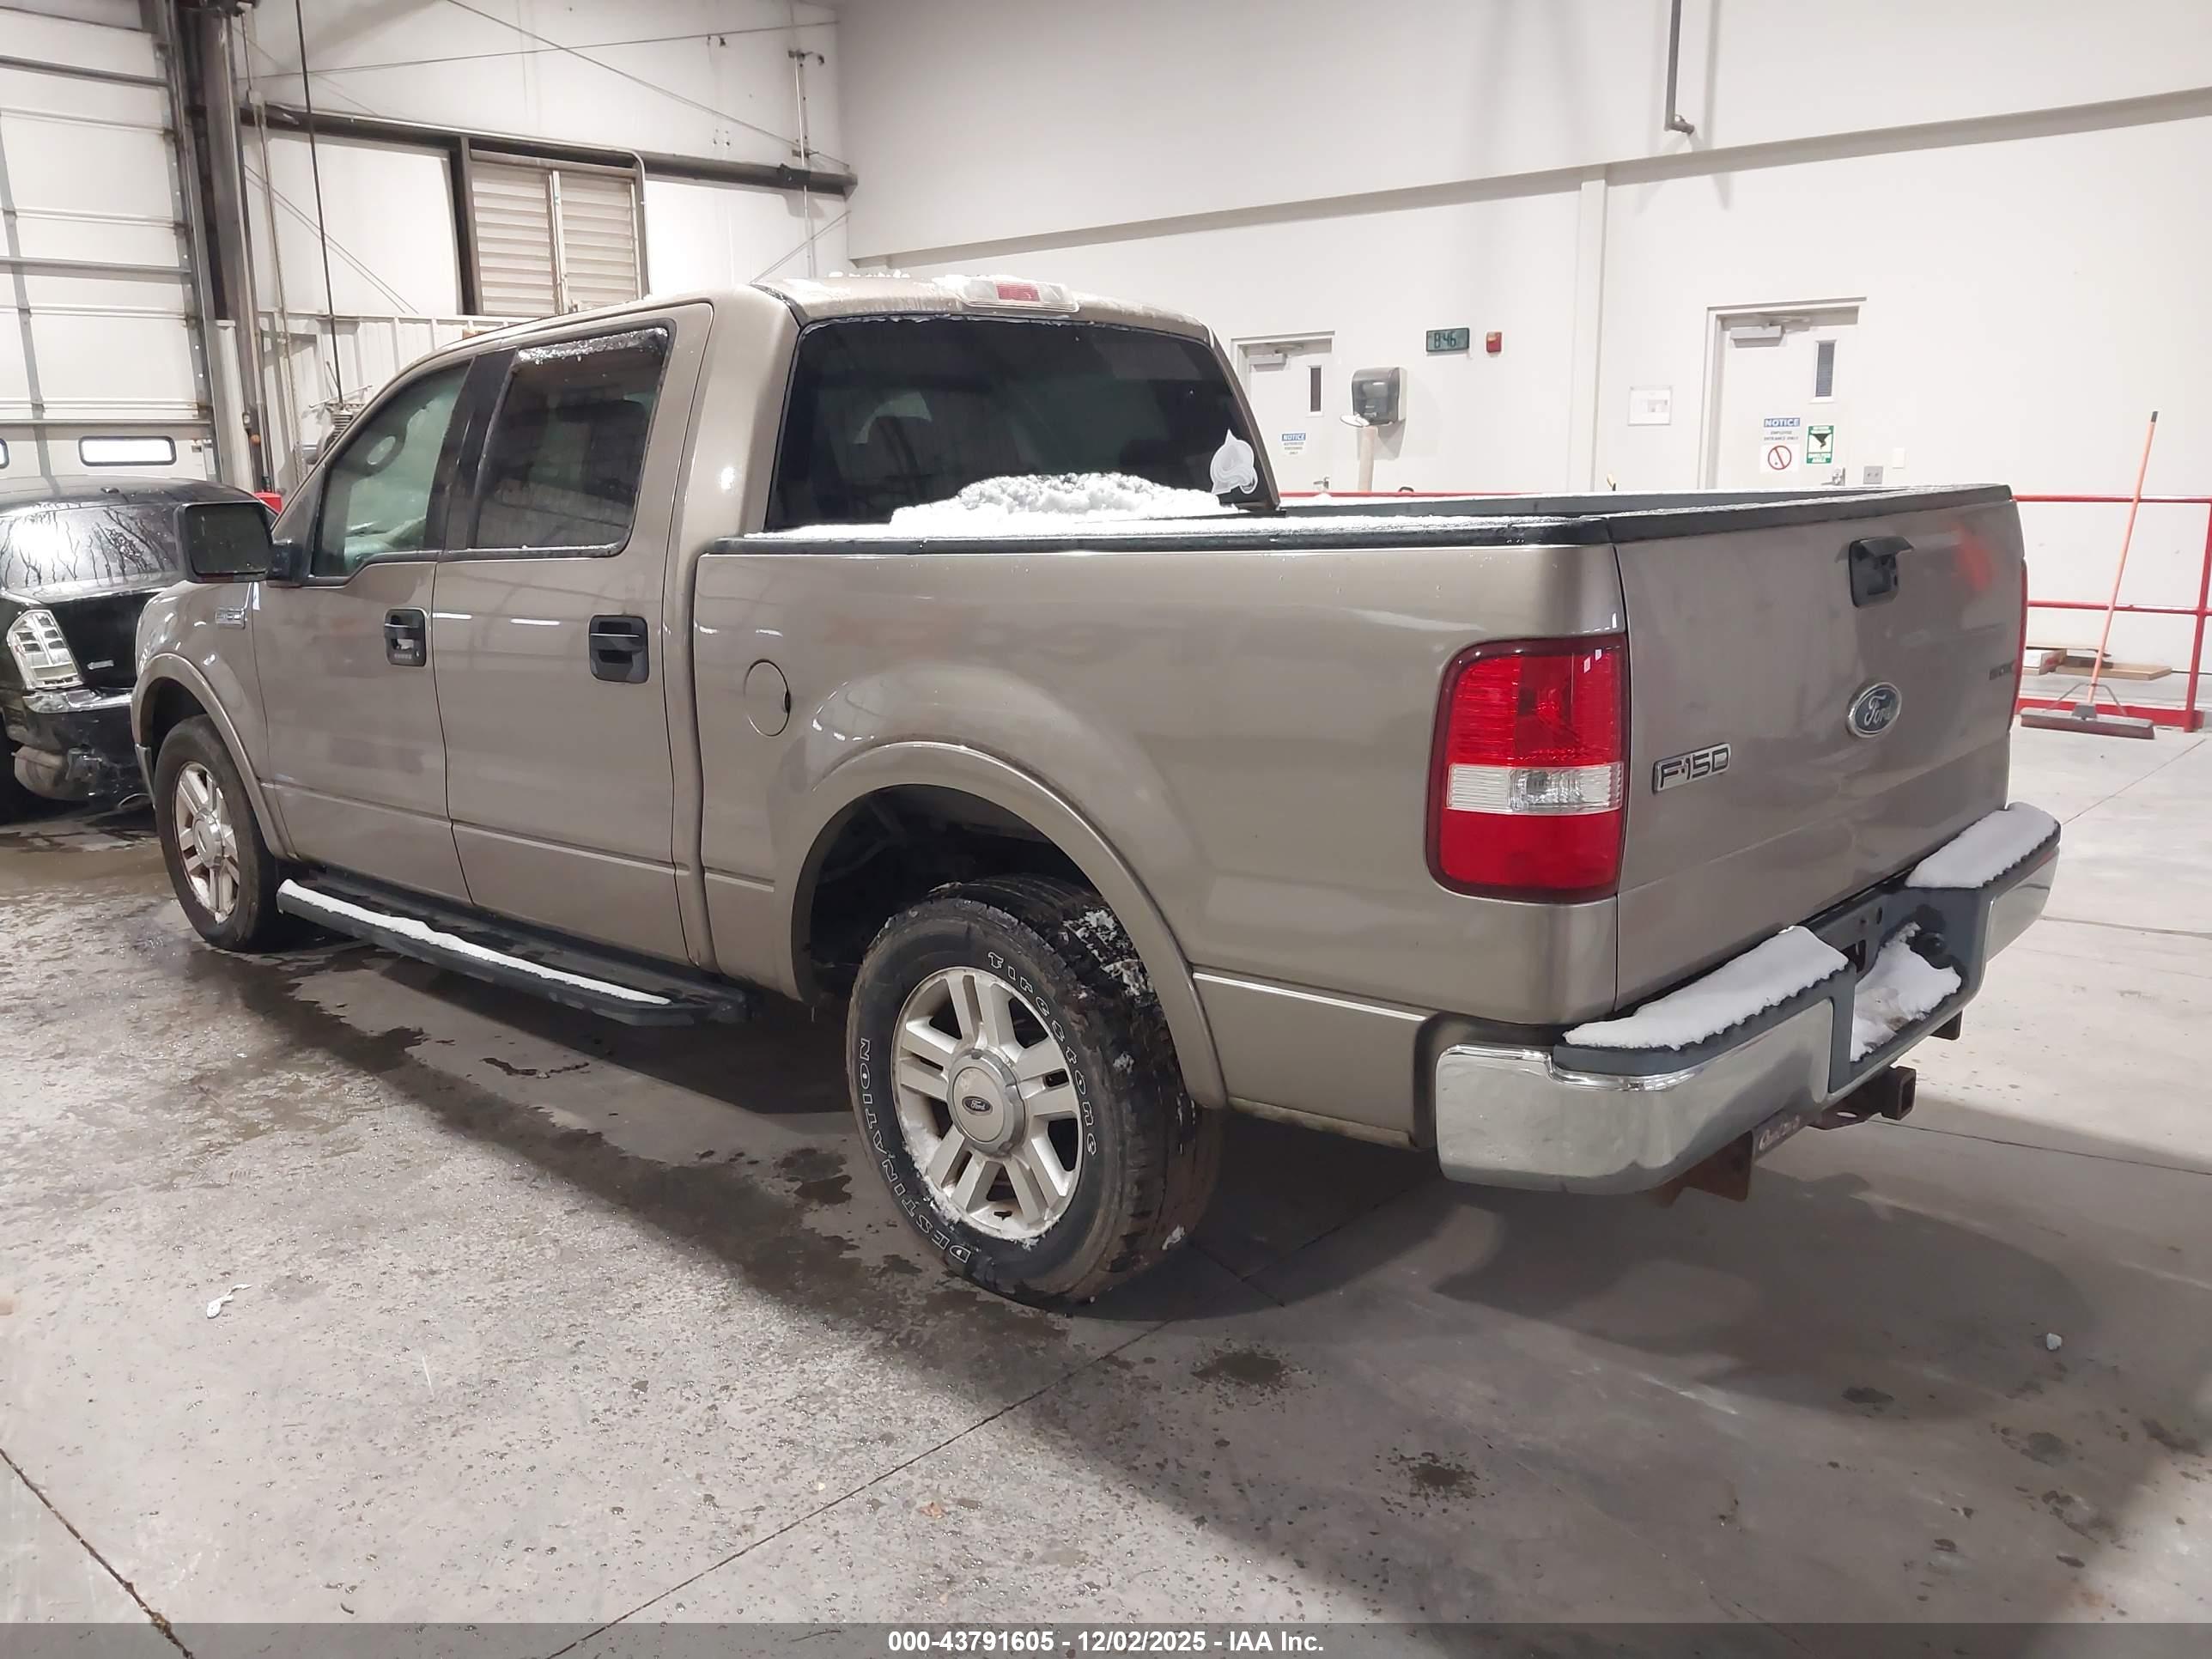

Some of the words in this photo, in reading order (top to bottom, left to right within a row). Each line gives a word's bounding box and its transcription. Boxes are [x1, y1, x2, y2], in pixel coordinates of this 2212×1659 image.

[1765, 418, 1800, 427] NOTICE
[1659, 746, 1730, 788] F-150
[859, 1037, 972, 1264] DESTINATION
